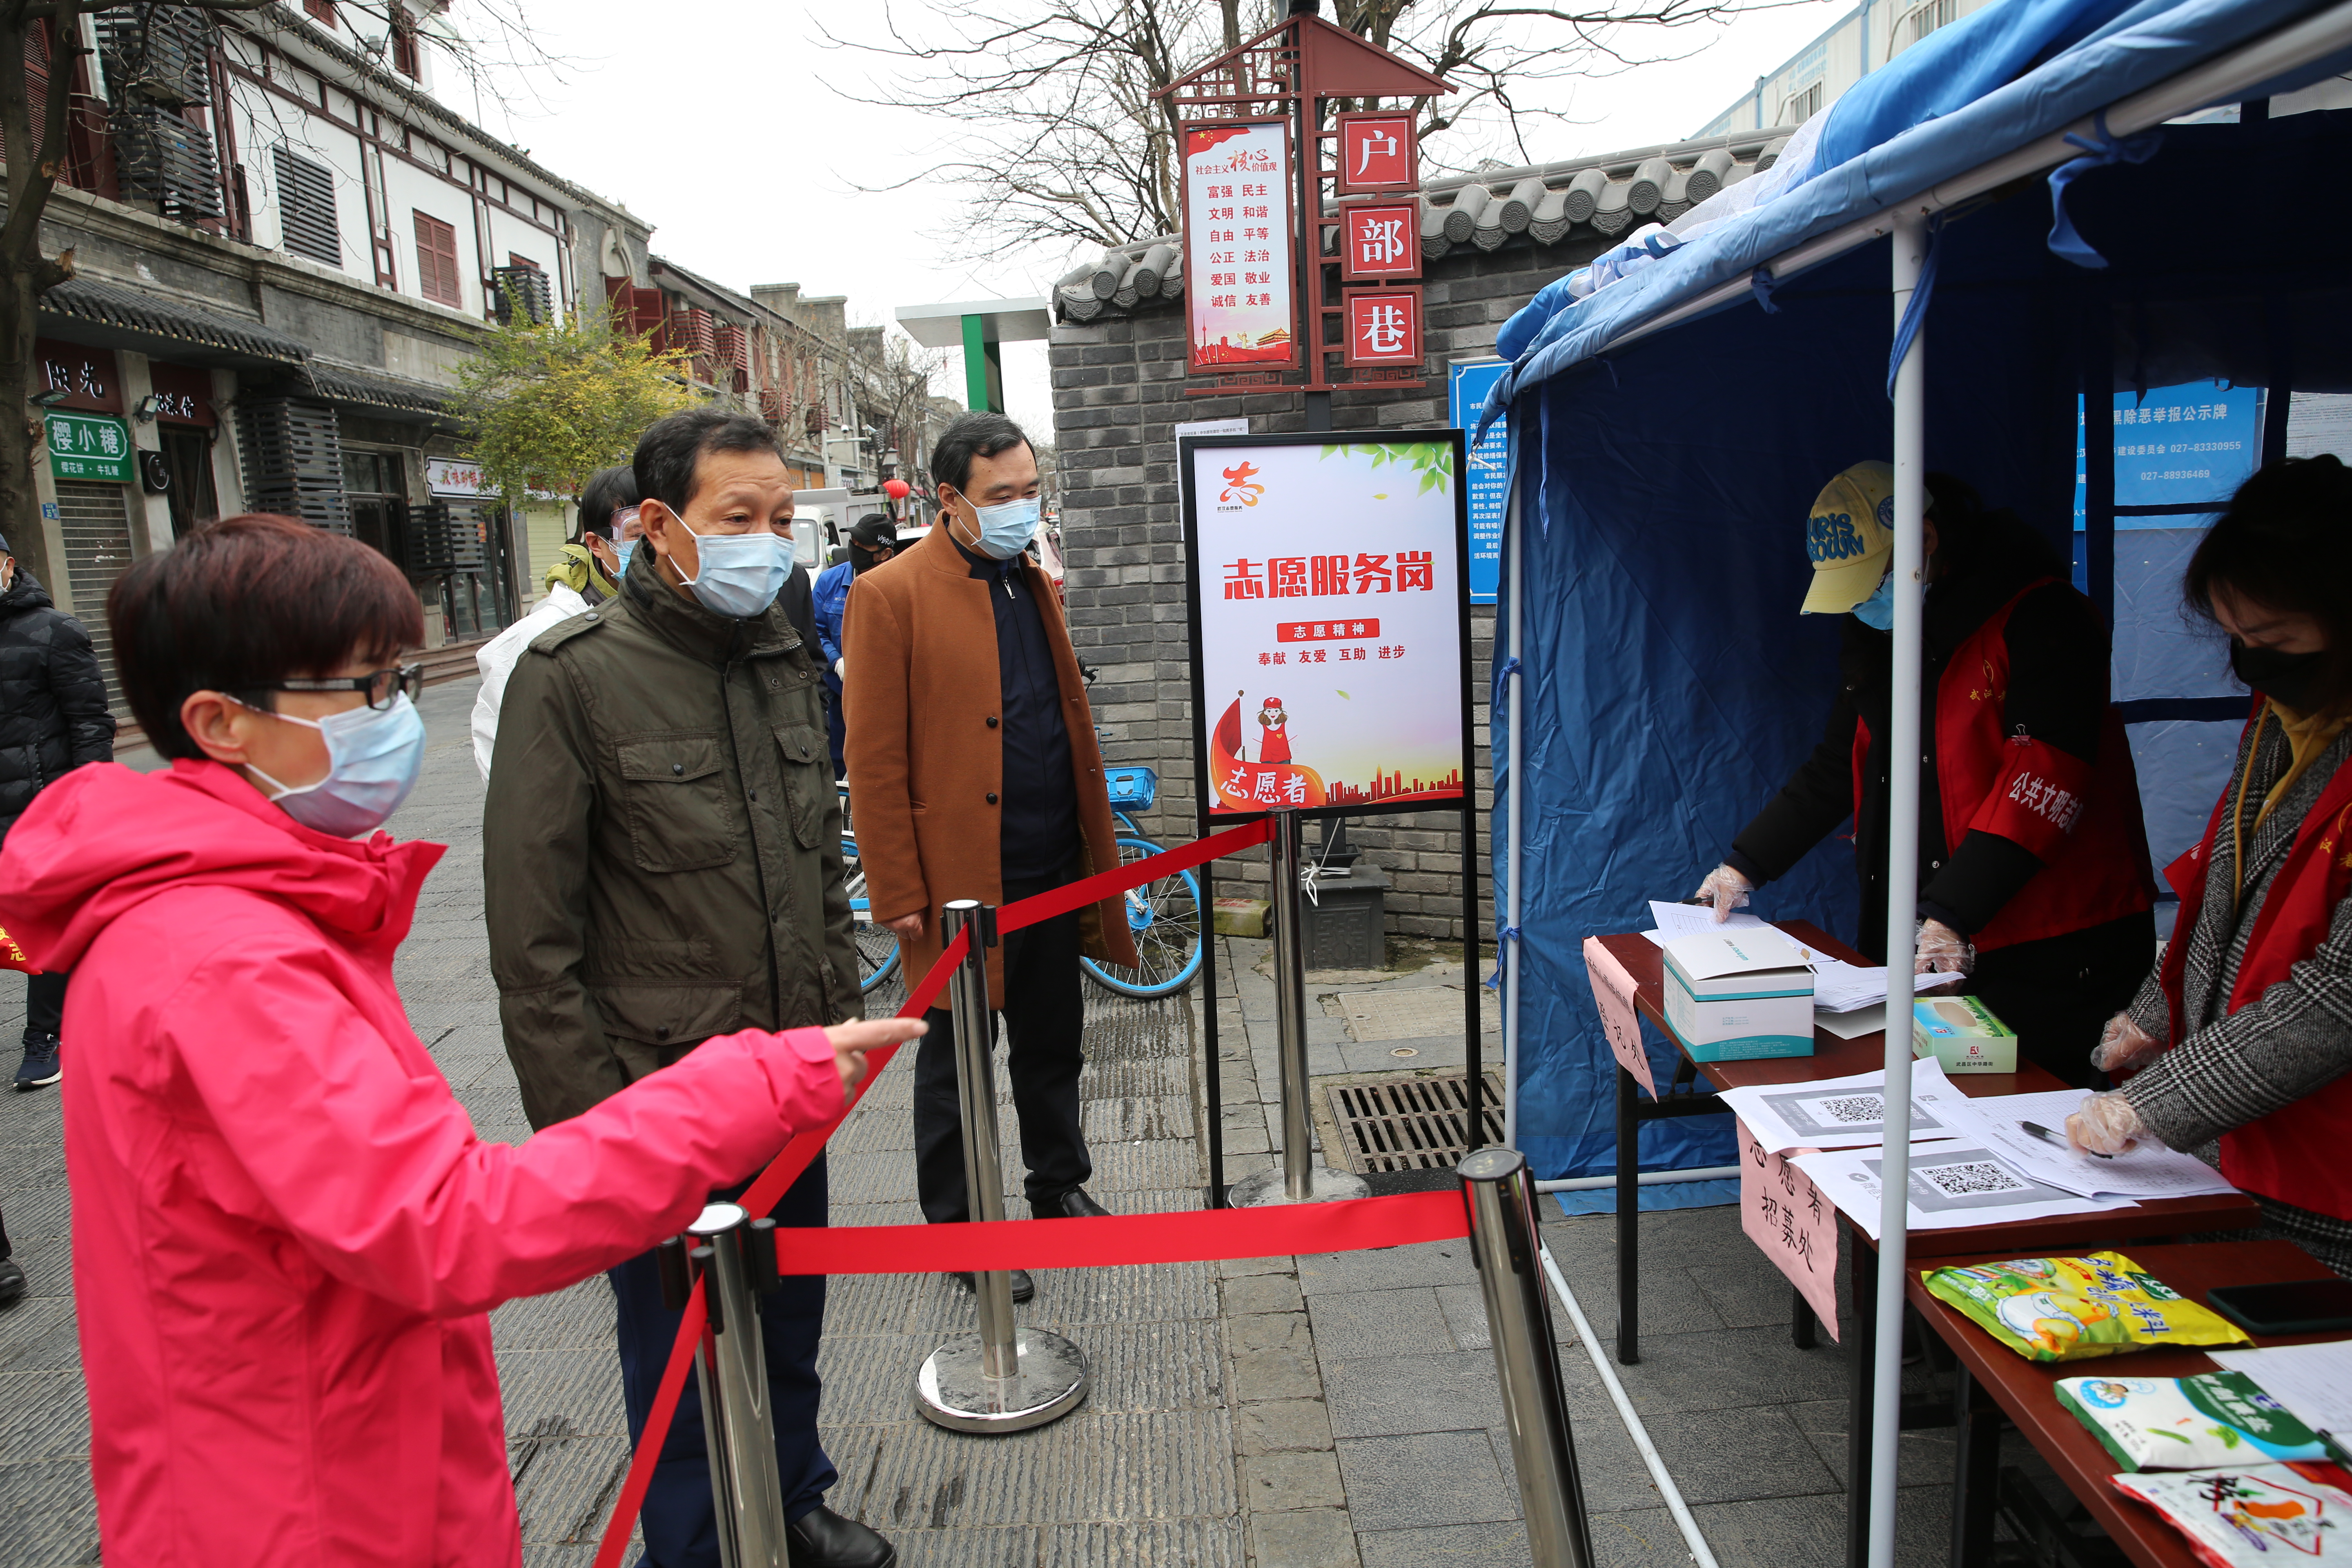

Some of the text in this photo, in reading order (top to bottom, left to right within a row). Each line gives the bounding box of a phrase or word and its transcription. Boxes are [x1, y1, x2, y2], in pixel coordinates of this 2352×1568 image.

[1207, 184, 1268, 198] 富强 民主
[1208, 205, 1268, 220] 文明 和谐
[1209, 227, 1269, 242] 自由 平等
[1356, 130, 1405, 352] 户部巷
[1209, 249, 1270, 264] 公正 法治
[1210, 271, 1270, 286] 爱国 敬业
[1211, 293, 1271, 307] 诚信 友善
[52, 421, 119, 454] 樱小糖
[2170, 441, 2241, 453] 027-83330955
[2141, 470, 2209, 481] 027-88936469
[1223, 550, 1433, 600] 志愿服务岗
[1293, 623, 1365, 639] 志愿精神
[1258, 644, 1406, 666] 奉献 友爱 互助 进步
[1220, 766, 1307, 803] 志愿者
